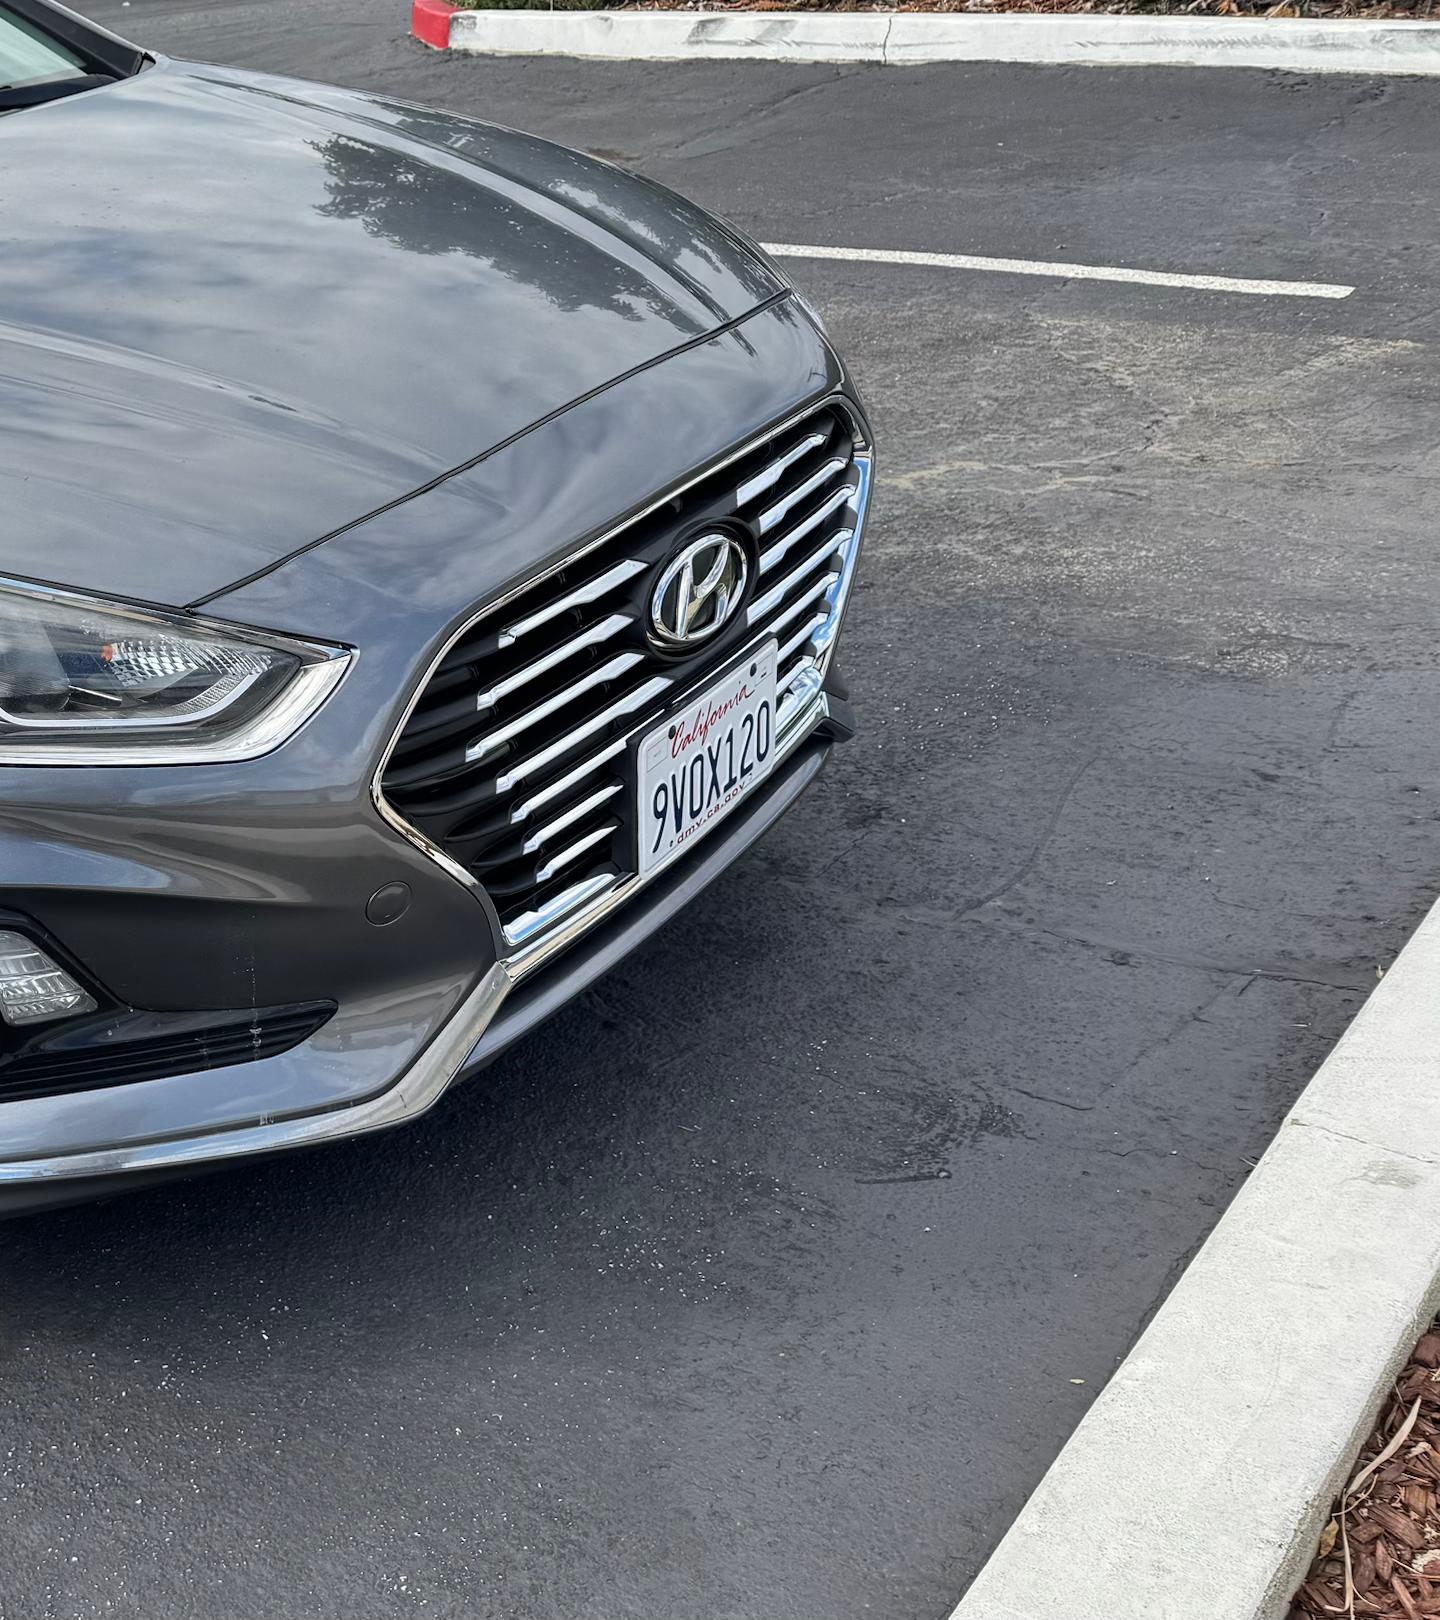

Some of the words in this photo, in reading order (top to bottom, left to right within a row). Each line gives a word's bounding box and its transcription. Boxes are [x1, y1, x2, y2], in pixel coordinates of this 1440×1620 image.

[671, 681, 756, 759] California
[653, 700, 770, 854] 9VOX120
[677, 782, 745, 844] dmv.ca.gov
